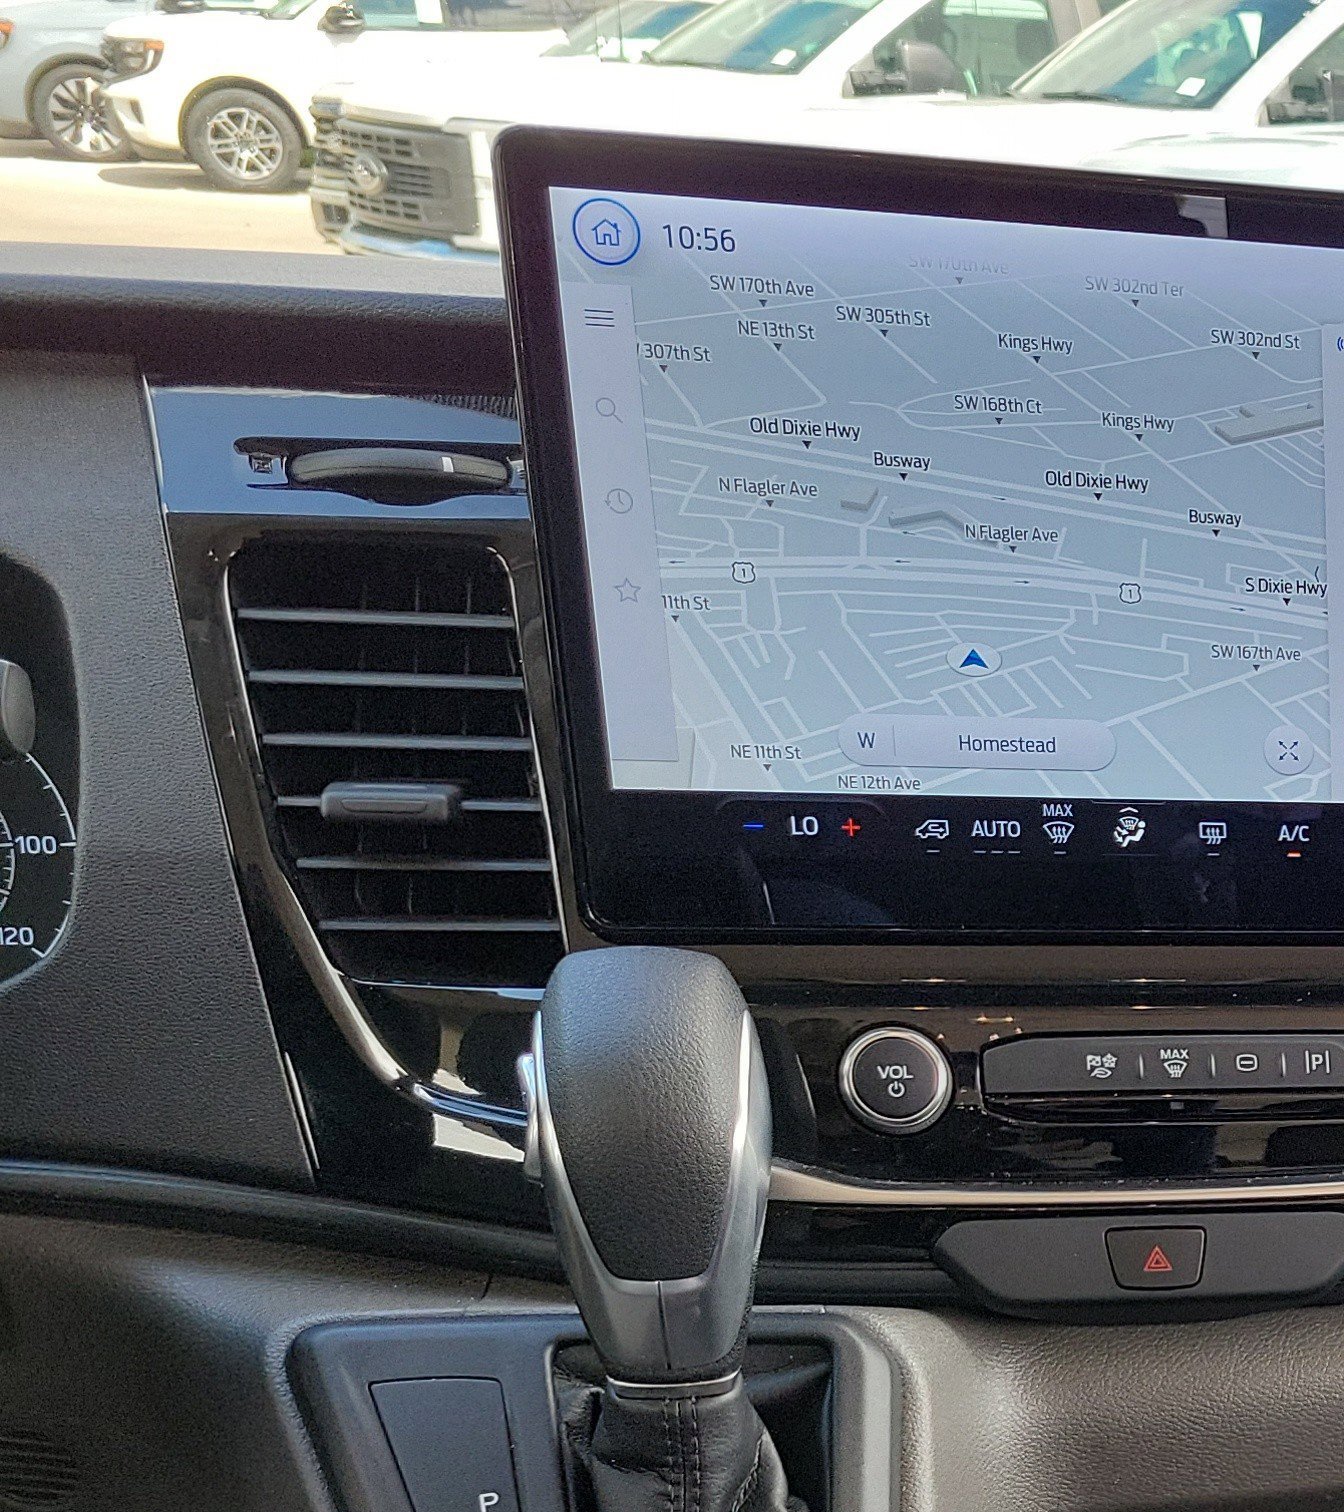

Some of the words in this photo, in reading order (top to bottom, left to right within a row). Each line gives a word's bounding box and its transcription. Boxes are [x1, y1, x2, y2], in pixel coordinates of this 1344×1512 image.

[662, 223, 737, 253] 10:56
[710, 275, 739, 291] SW
[739, 276, 782, 295] 170th
[786, 280, 815, 296] Ave
[1084, 276, 1110, 291] SW
[1112, 278, 1158, 294] 302nd
[1160, 281, 1185, 297] Ter
[836, 306, 861, 321] SW
[864, 308, 910, 325] 305th
[912, 310, 931, 326] St
[738, 321, 760, 336] NE
[762, 322, 794, 339] 13th
[797, 324, 815, 340] St
[1210, 330, 1236, 345] SW
[1238, 331, 1281, 348] 302nd
[1284, 334, 1300, 350] St
[643, 343, 690, 360] 307th
[693, 346, 711, 361] St
[998, 334, 1038, 354] Kings
[1041, 336, 1073, 355] Hwy
[953, 395, 979, 411] SW
[982, 396, 1023, 413] 168th
[1025, 398, 1042, 414] Ct
[750, 418, 779, 435] Old
[782, 419, 822, 437] Dixie
[824, 422, 860, 441] Hwy
[1101, 412, 1140, 432] Kings
[1143, 415, 1175, 432] Hwy
[874, 452, 930, 470] Busway
[718, 477, 730, 491] N
[733, 478, 786, 499] Flagler
[789, 482, 818, 497] Ave
[1045, 471, 1073, 487] Old
[1077, 472, 1111, 489] Dixie
[1115, 475, 1149, 492] Hwy
[1188, 509, 1242, 527] Busway
[965, 524, 976, 538] N
[978, 525, 1029, 545] Flagler
[1031, 528, 1059, 542] Ave
[1246, 578, 1254, 592] S
[1258, 578, 1293, 594] Dixie
[1296, 580, 1328, 597] Hwy
[661, 595, 689, 610] 11th
[692, 596, 710, 611] St
[1211, 645, 1235, 659] SW
[1238, 646, 1273, 660] 167th
[1276, 648, 1300, 661] Ave
[857, 732, 875, 748] W
[958, 734, 1056, 754] Homestead
[731, 745, 751, 758] NE
[754, 745, 781, 759] 11th
[785, 746, 801, 760] St
[838, 775, 856, 789] NE
[860, 776, 891, 790] 12th
[894, 777, 921, 791] Ave
[1043, 804, 1073, 818] MAX
[790, 815, 818, 836] LO
[972, 821, 1021, 838] AUTO
[1278, 825, 1310, 842] A/C
[14, 835, 57, 854] 100
[0, 926, 34, 946] 120
[1159, 1048, 1189, 1060] MAX
[876, 1065, 913, 1080] VOL
